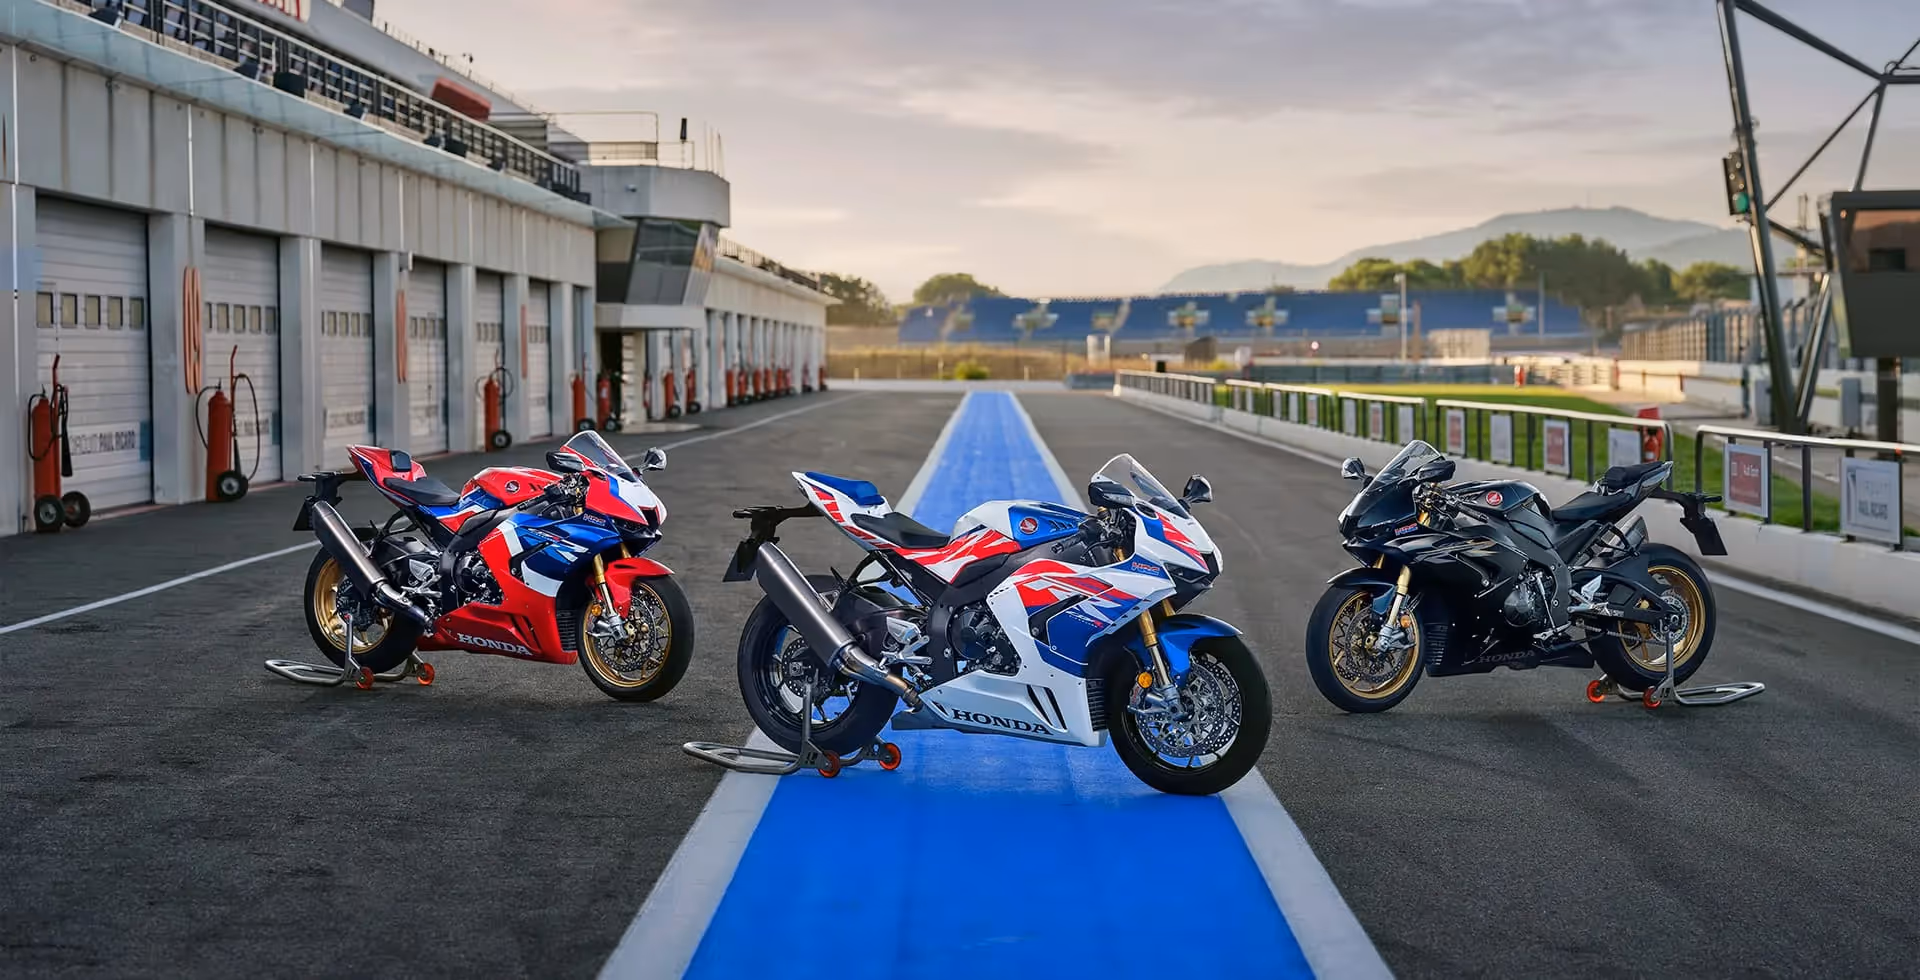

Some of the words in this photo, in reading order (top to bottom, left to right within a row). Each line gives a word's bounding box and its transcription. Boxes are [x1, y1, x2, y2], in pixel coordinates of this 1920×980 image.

[583, 512, 606, 527] HRC
[1394, 522, 1419, 537] HRC
[1131, 561, 1160, 576] HRC
[457, 632, 533, 656] HONDA
[1479, 649, 1535, 663] HONDA
[951, 708, 1054, 736] HONDA
